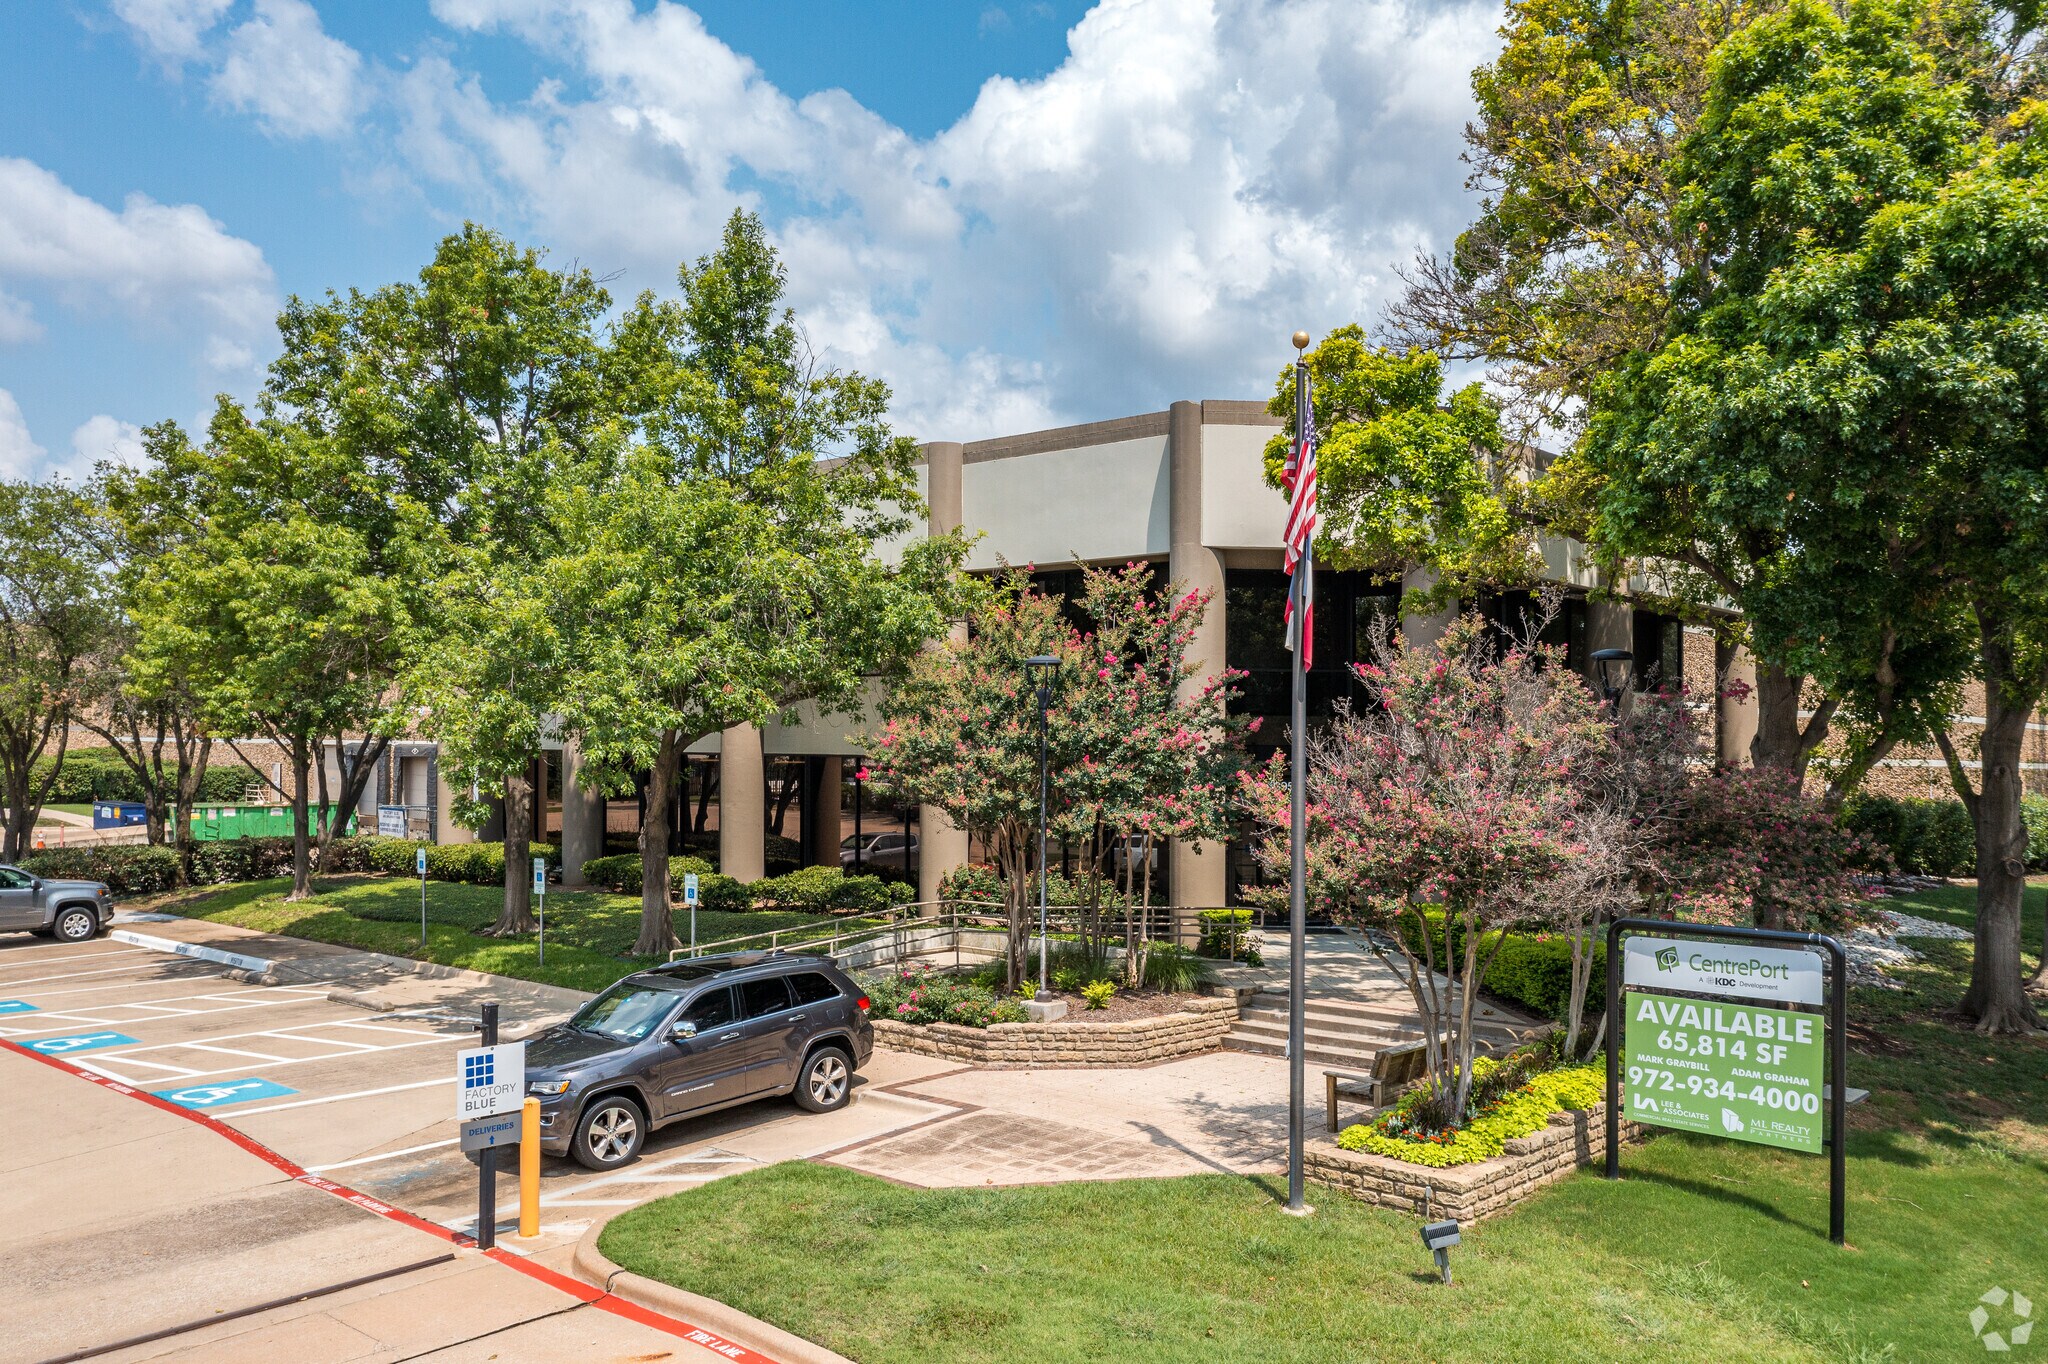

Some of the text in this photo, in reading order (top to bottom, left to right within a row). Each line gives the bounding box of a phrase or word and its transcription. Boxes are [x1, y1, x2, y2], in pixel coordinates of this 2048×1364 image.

[1689, 953, 1789, 980] CentrePort
[1714, 977, 1736, 987] KDC
[1739, 981, 1779, 990] Development
[1636, 1000, 1813, 1044] AVAILABLE
[1657, 1030, 1788, 1066] 65,814 SF
[1637, 1053, 1710, 1072] MARK GRAYBILL
[1731, 1067, 1810, 1086] ADAM GRAHAM
[465, 1083, 517, 1100] FACTORY
[1628, 1066, 1818, 1114] 972-934-4000
[465, 1097, 496, 1111] BLUE
[1661, 1100, 1674, 1108] LEE
[1633, 1112, 1661, 1120] COMMERCIAL
[1689, 1121, 1710, 1129] SERVICES
[1663, 1107, 1710, 1121] ASSOCIATES
[469, 1122, 514, 1136] DELIVERIES
[1750, 1118, 1811, 1136] ML REALTY
[1750, 1129, 1811, 1145] PARTNERS
[684, 1329, 746, 1359] FIRE LANE
